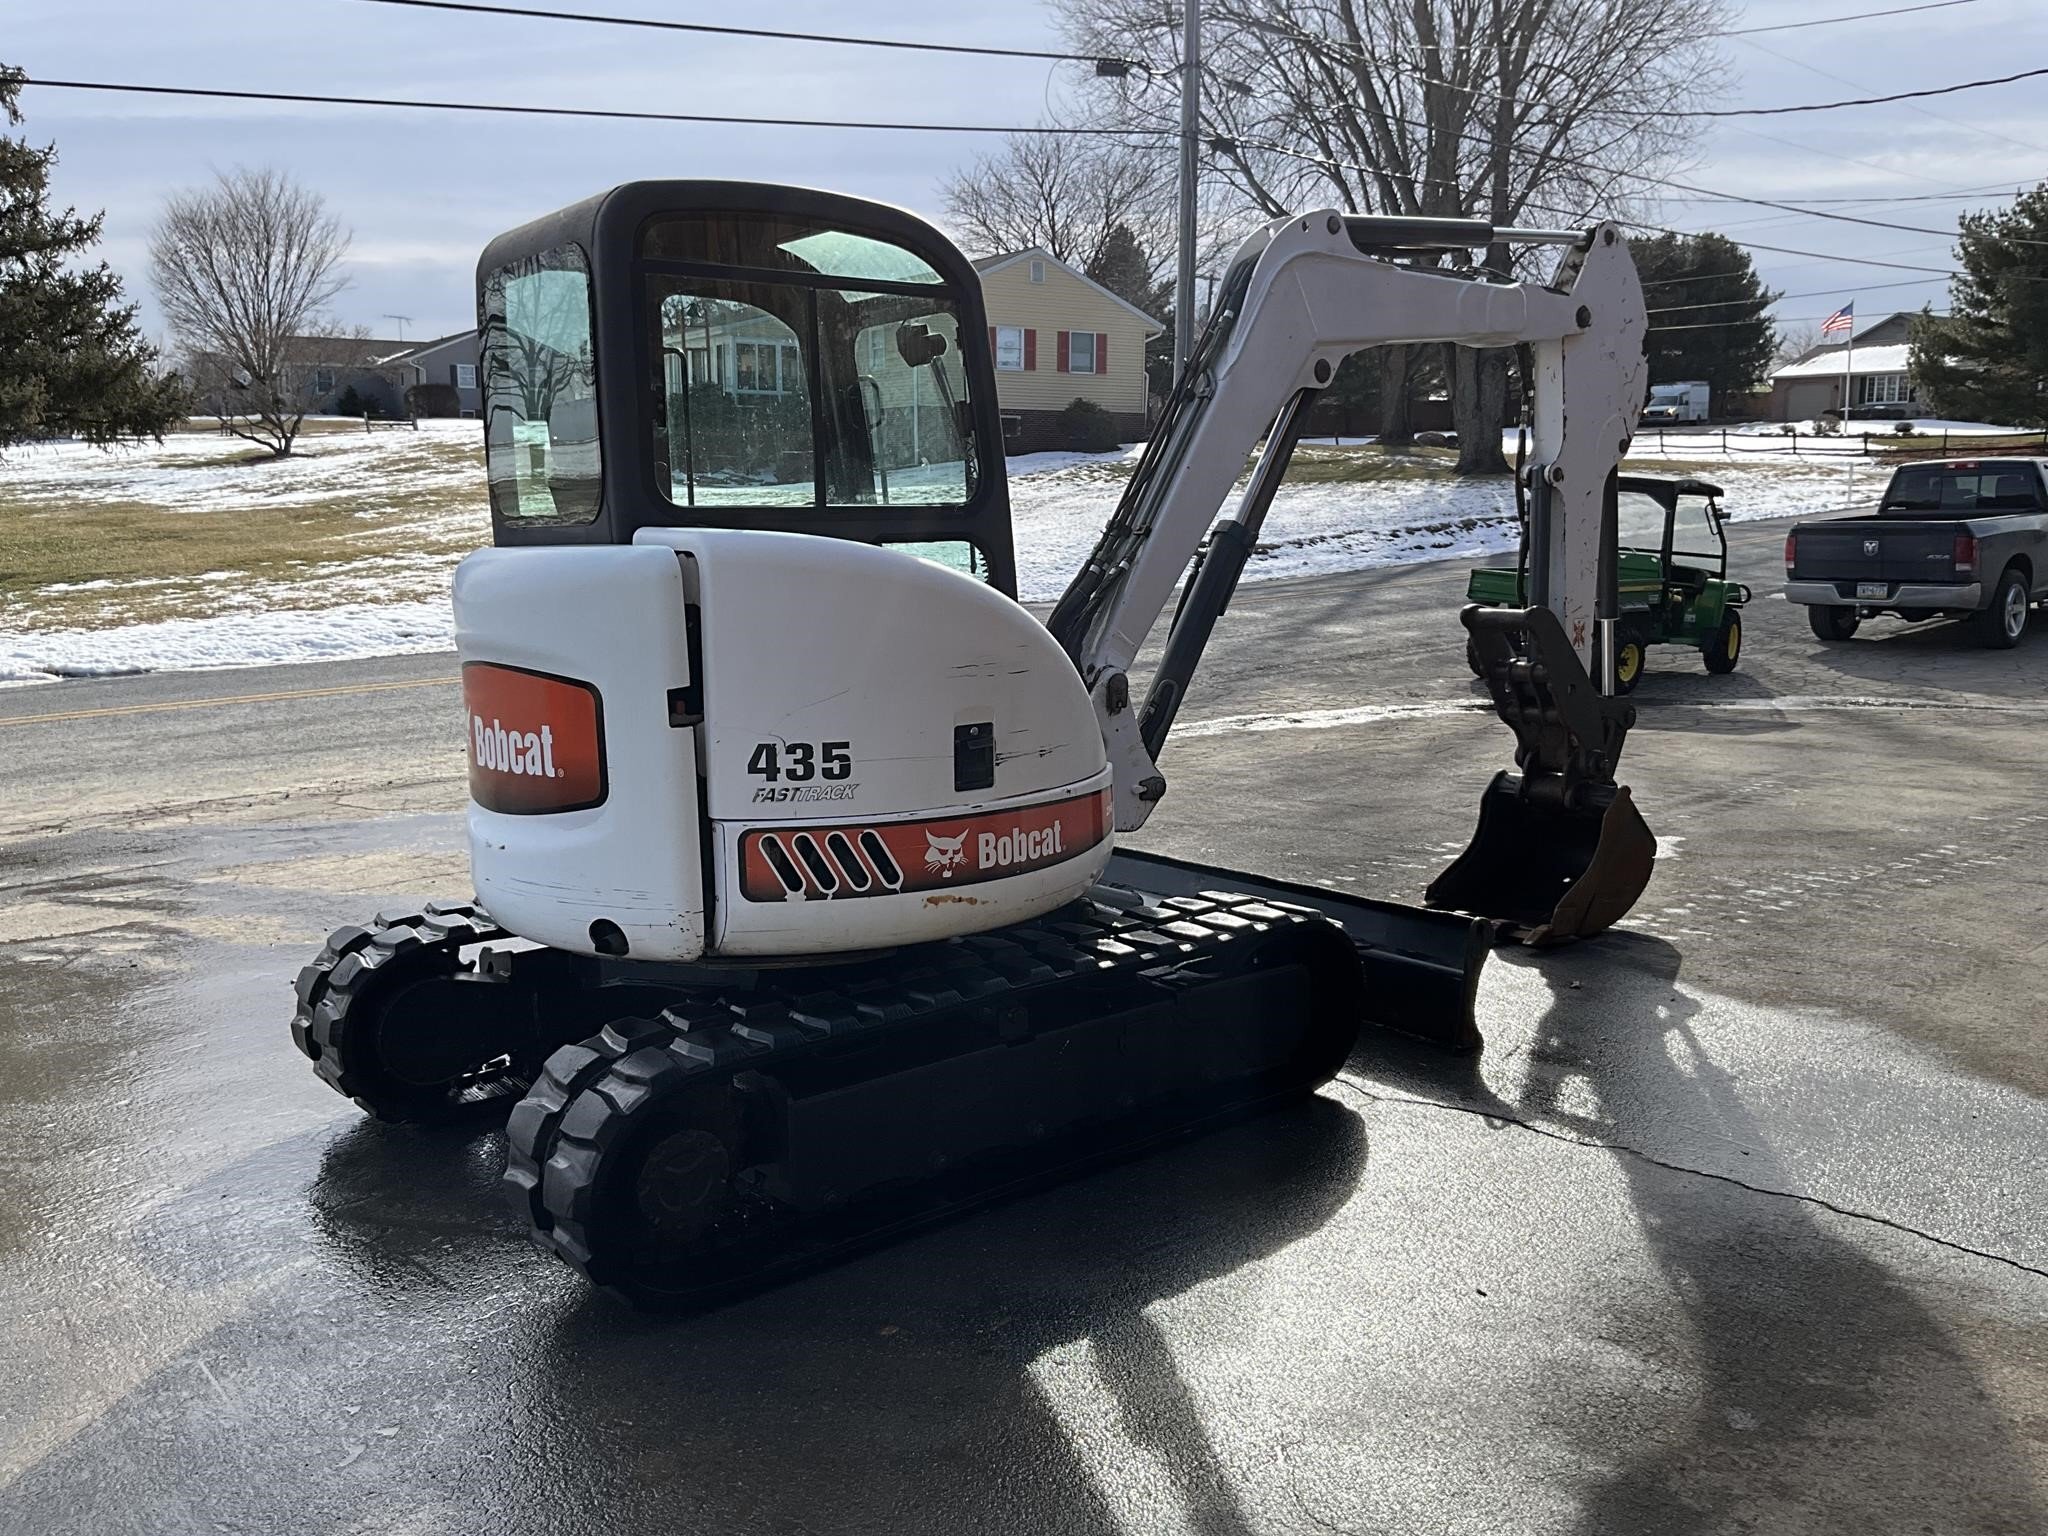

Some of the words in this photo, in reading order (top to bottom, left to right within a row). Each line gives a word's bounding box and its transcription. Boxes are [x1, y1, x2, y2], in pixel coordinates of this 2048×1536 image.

[474, 715, 556, 778] Bobcat
[748, 741, 851, 782] 435
[978, 820, 1062, 870] Bobcat
